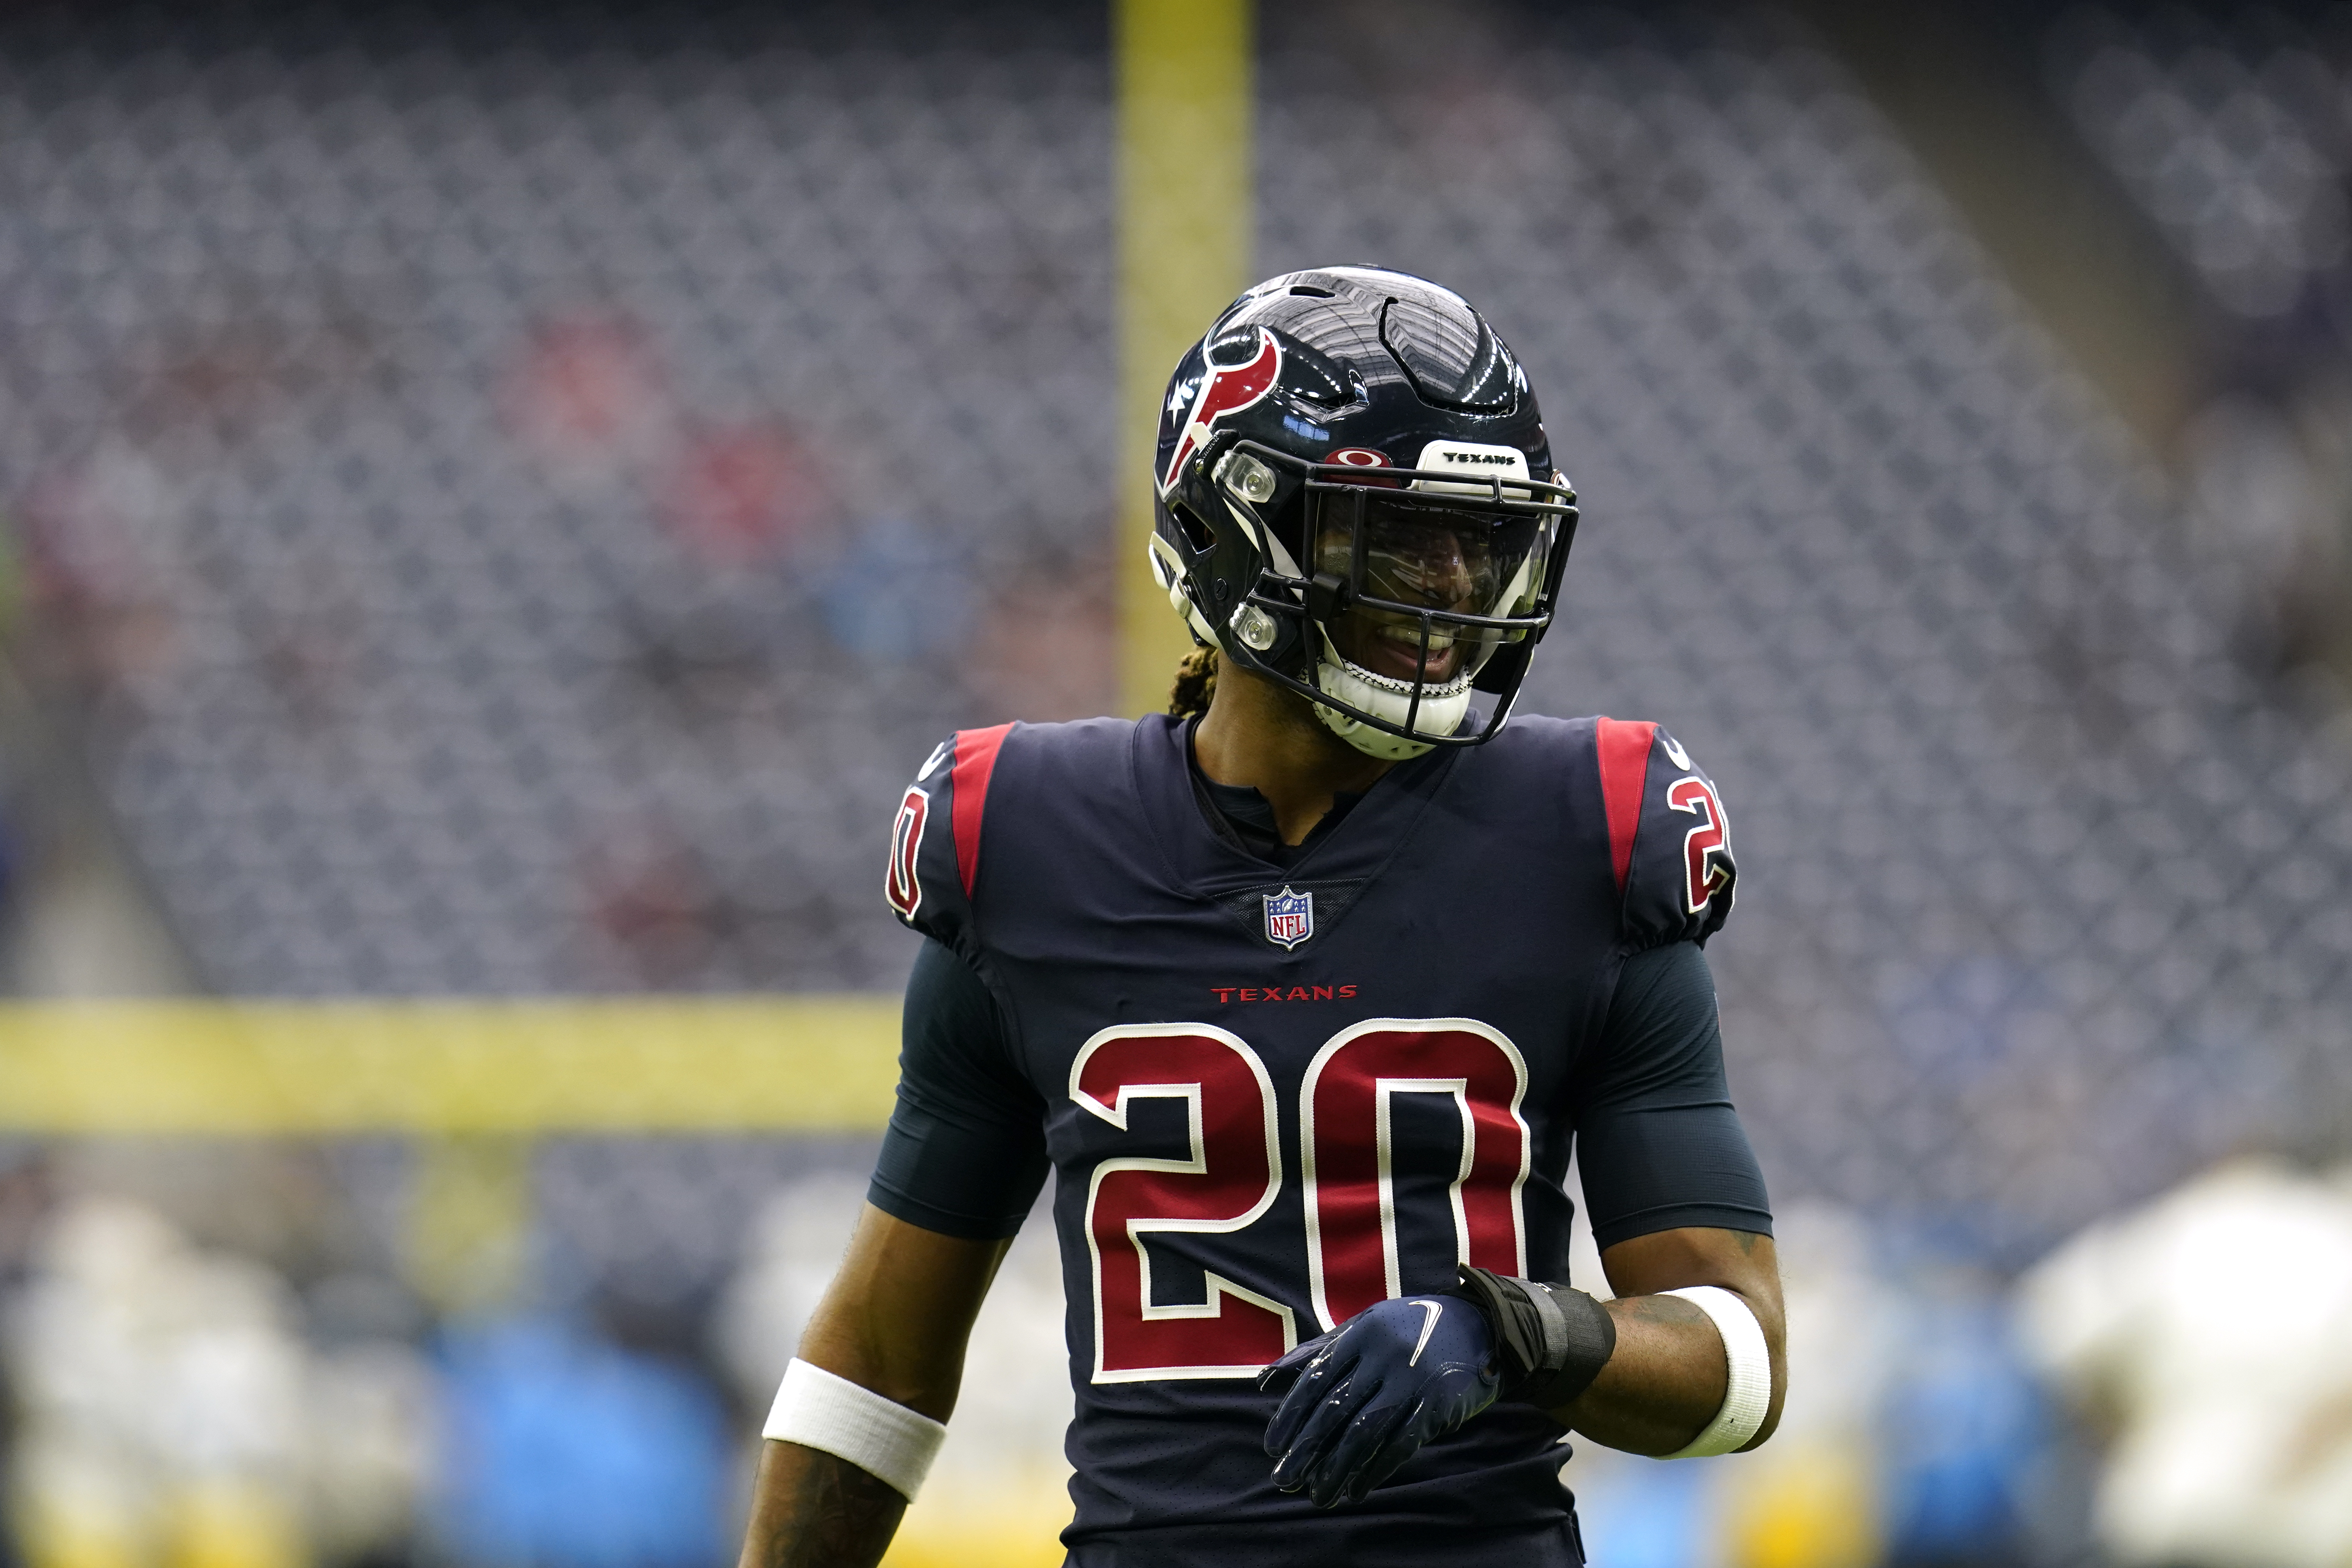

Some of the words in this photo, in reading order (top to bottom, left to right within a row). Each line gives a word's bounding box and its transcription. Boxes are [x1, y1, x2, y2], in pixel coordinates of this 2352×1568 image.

[1443, 452, 1516, 465] TEXANS
[1667, 776, 1738, 914] 2
[1272, 914, 1305, 937] NFL
[1210, 985, 1357, 1003] TEXANS
[1069, 1017, 1531, 1384] 20
